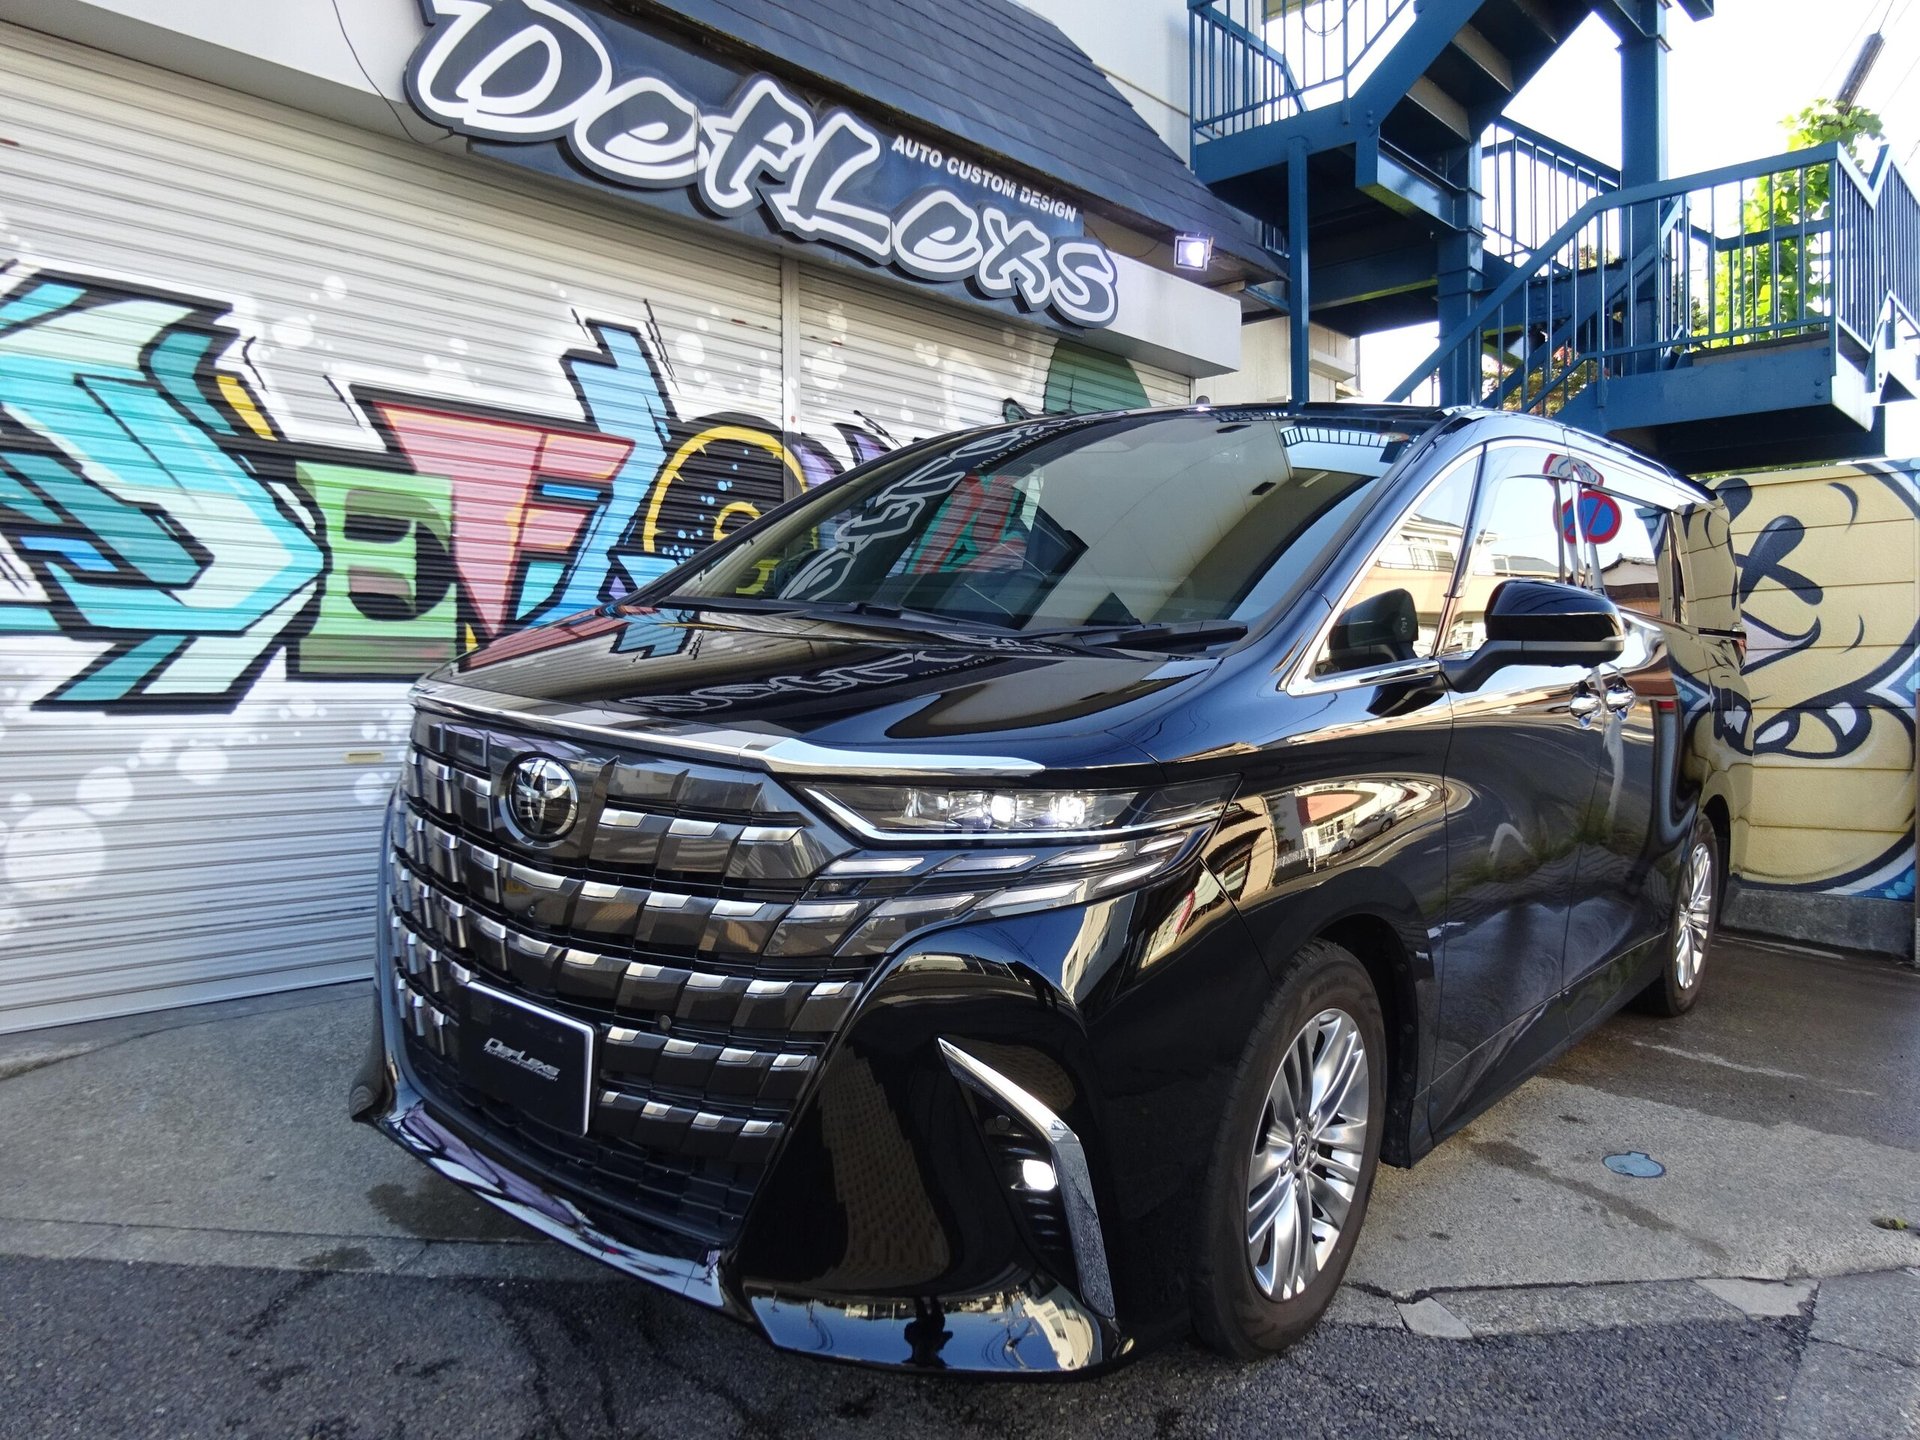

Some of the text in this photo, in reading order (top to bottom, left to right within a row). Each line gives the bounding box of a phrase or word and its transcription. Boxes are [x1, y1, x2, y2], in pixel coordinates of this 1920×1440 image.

[891, 134, 1077, 223] AUTO CUSTOM DESIGN
